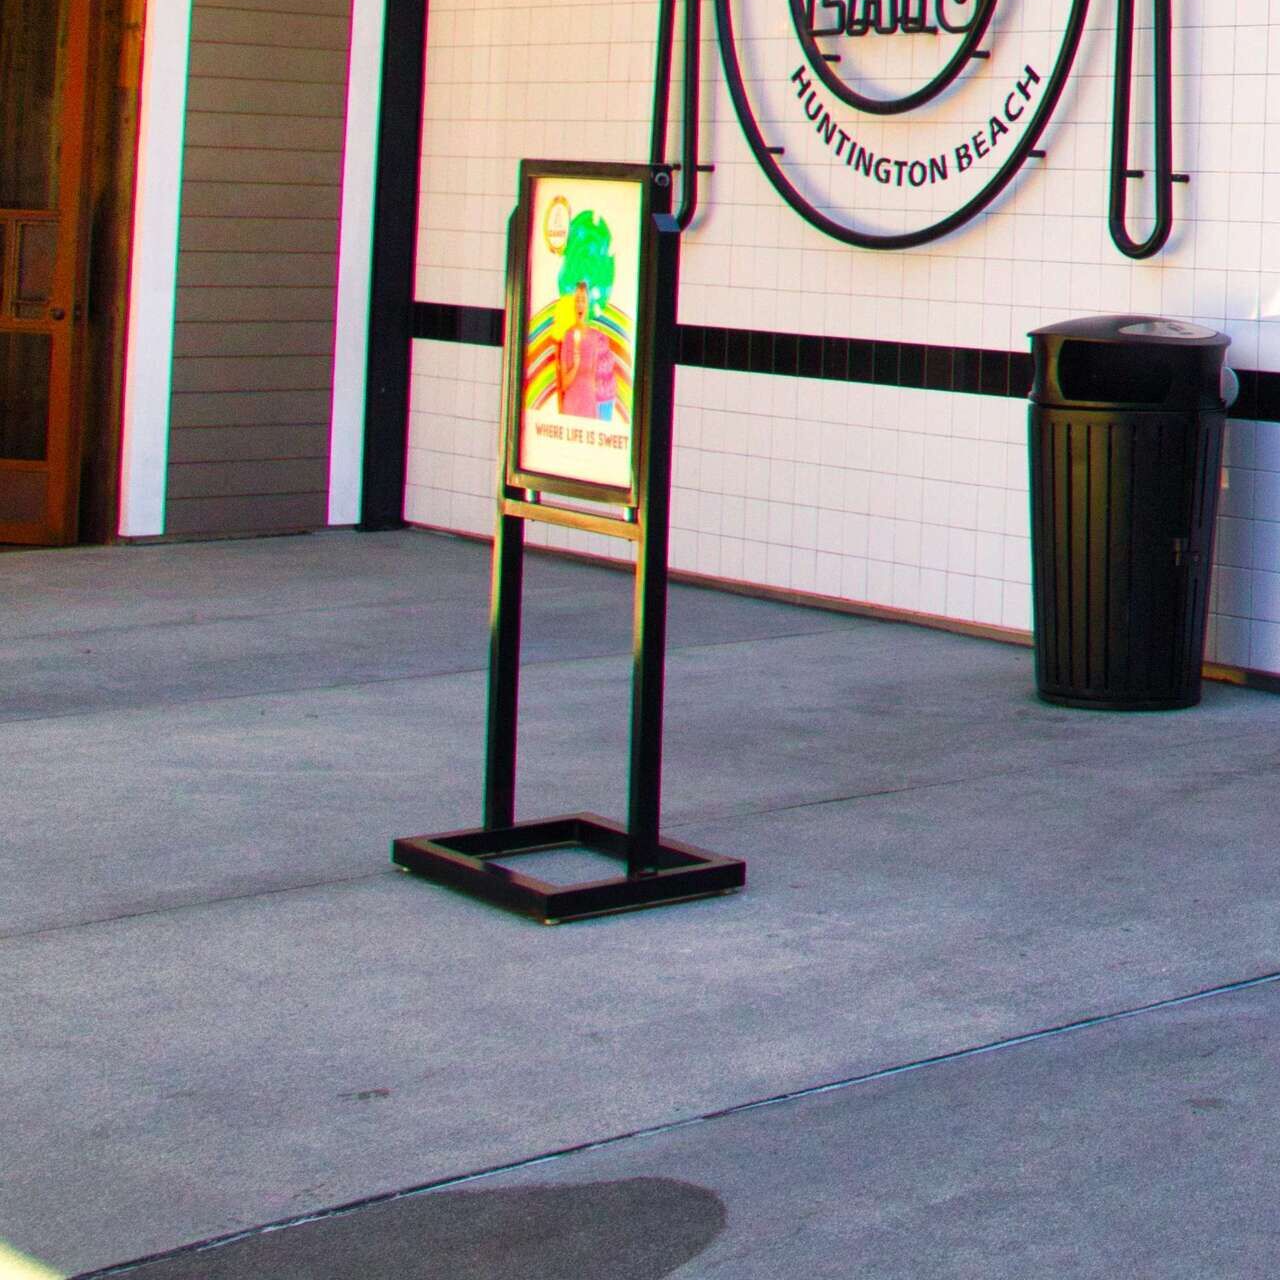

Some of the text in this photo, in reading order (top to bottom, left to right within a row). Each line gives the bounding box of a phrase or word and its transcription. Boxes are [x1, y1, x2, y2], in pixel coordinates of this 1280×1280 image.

[789, 65, 1042, 187] HUNTINGTON BEACH
[535, 423, 629, 449] WHERE LIFE IS SWEET
